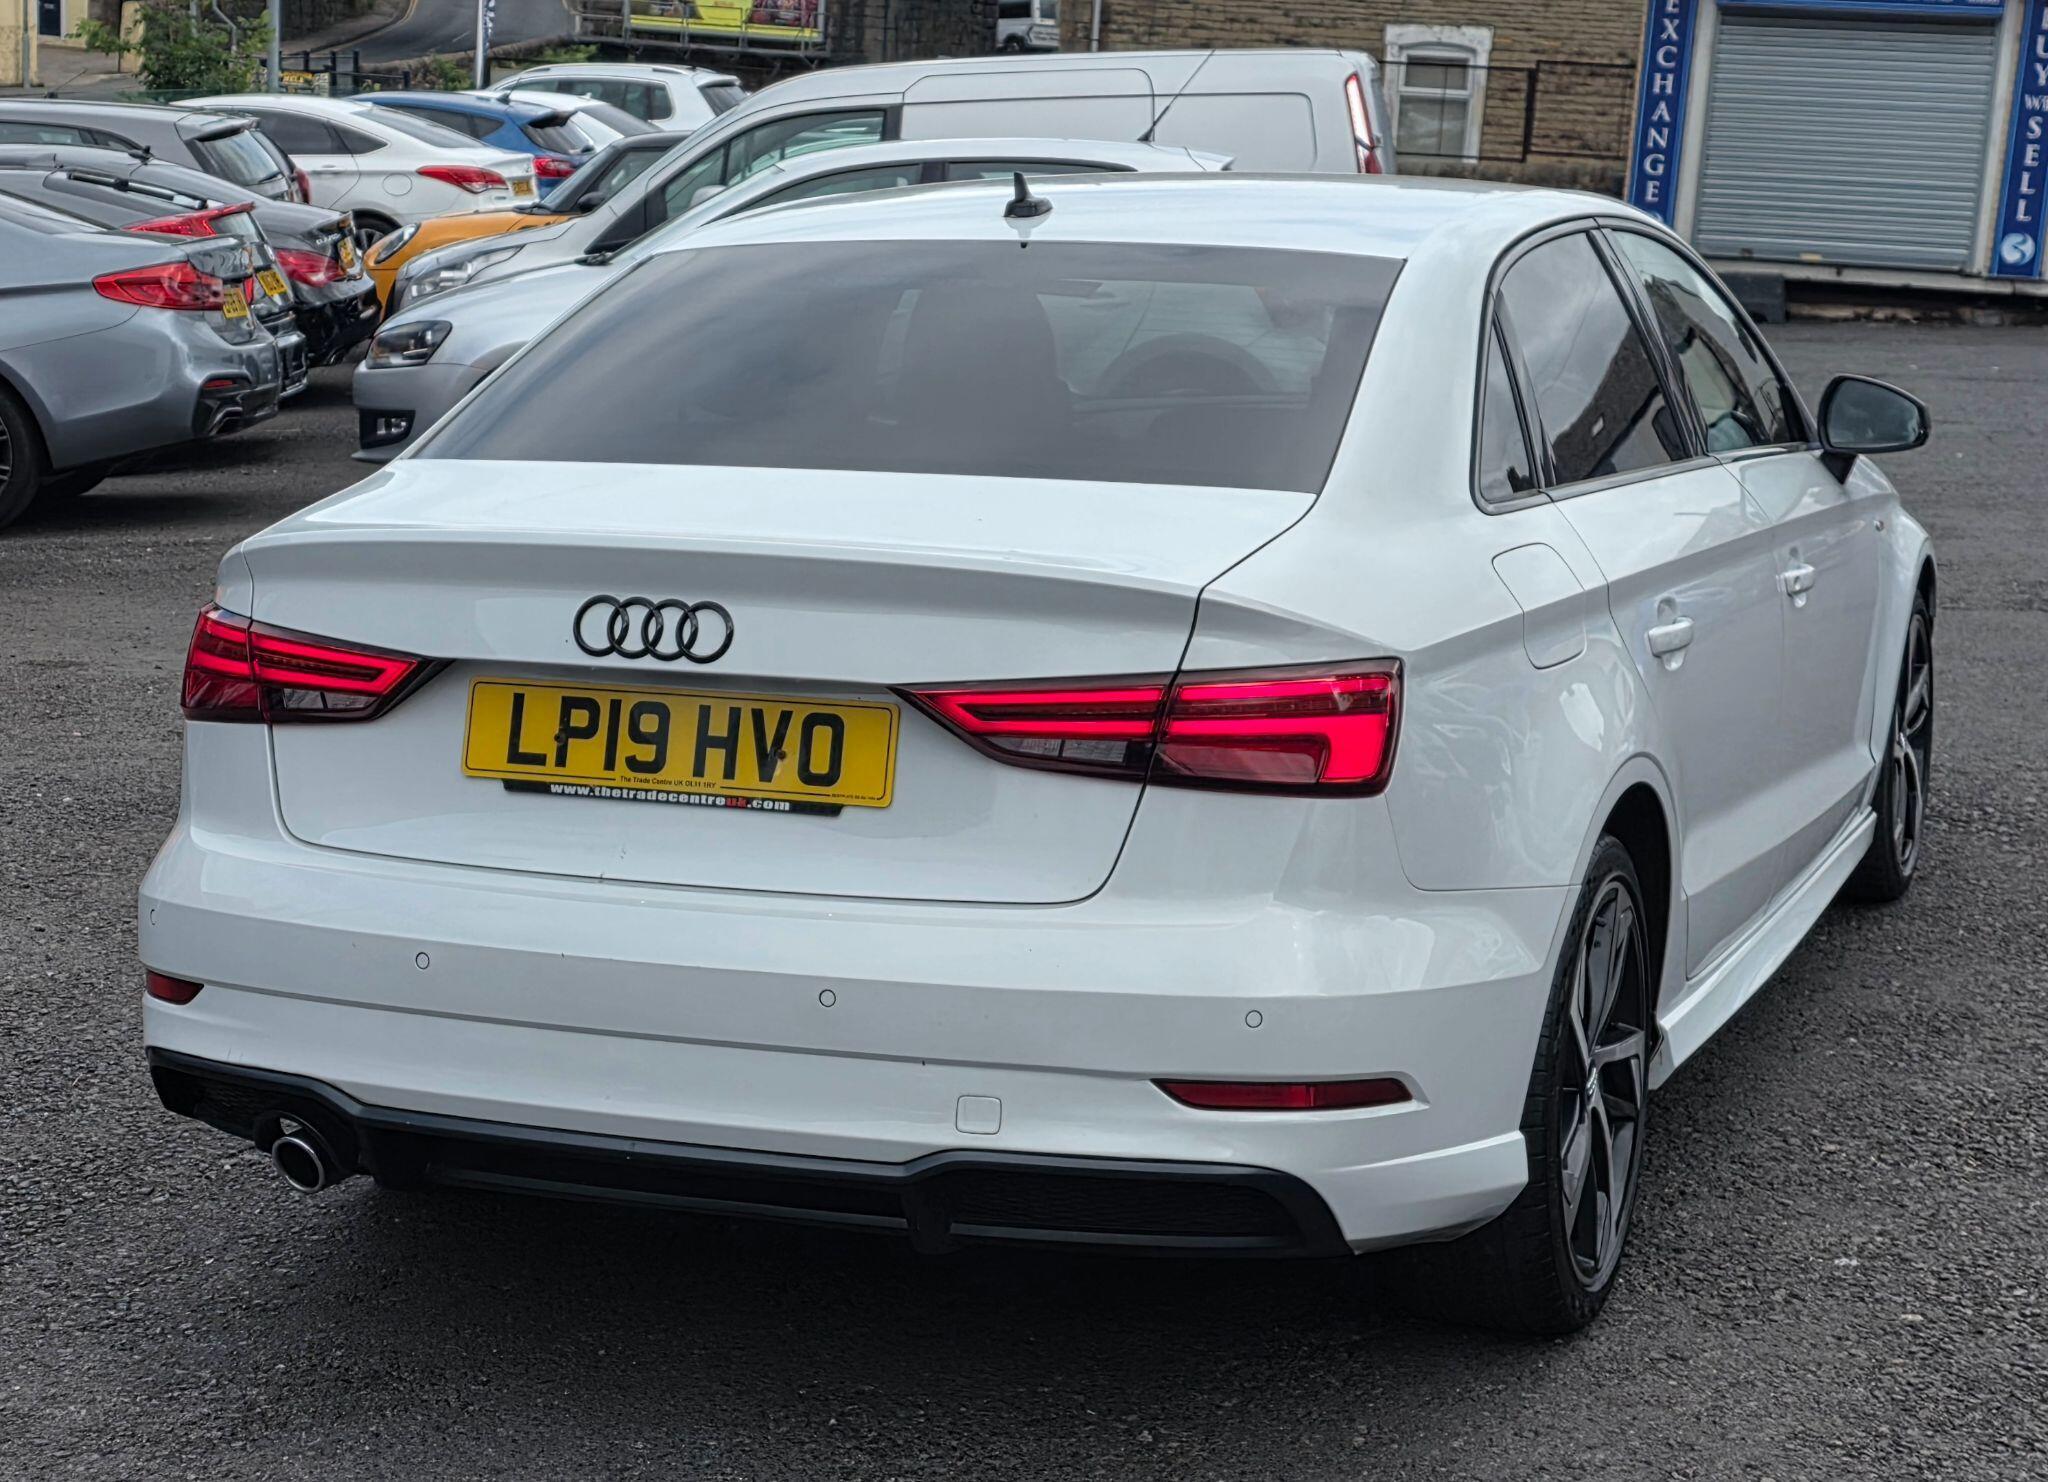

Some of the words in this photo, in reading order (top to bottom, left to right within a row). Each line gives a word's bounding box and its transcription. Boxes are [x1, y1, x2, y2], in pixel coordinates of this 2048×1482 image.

[1643, 0, 1680, 202] EXCHANGE
[2016, 116, 2043, 222] SELL
[506, 692, 671, 774] LP19
[693, 704, 844, 787] HVO
[620, 775, 631, 783] The
[633, 776, 650, 784] Trade
[651, 777, 672, 786] Centre
[550, 783, 790, 811] www.thetradecentreuk.com
